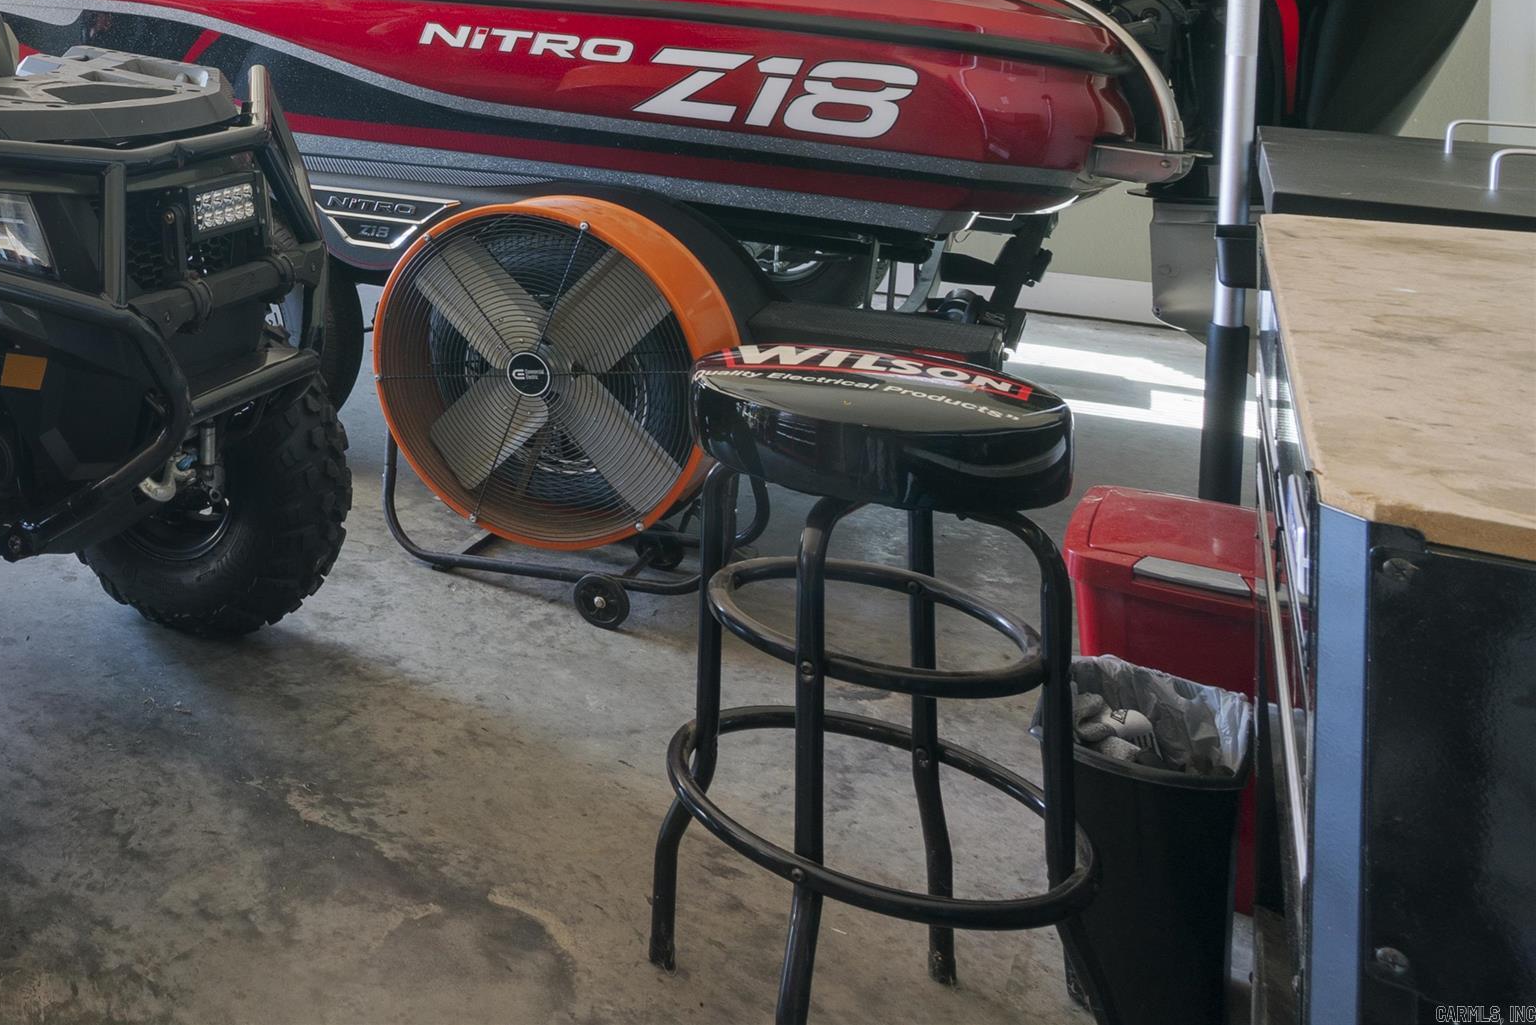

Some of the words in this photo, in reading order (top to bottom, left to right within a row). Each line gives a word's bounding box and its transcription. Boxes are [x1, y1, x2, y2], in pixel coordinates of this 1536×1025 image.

[633, 47, 920, 139] Z18
[359, 224, 390, 238] Z18
[738, 344, 1013, 392] WILSON
[766, 372, 879, 390] Electrical
